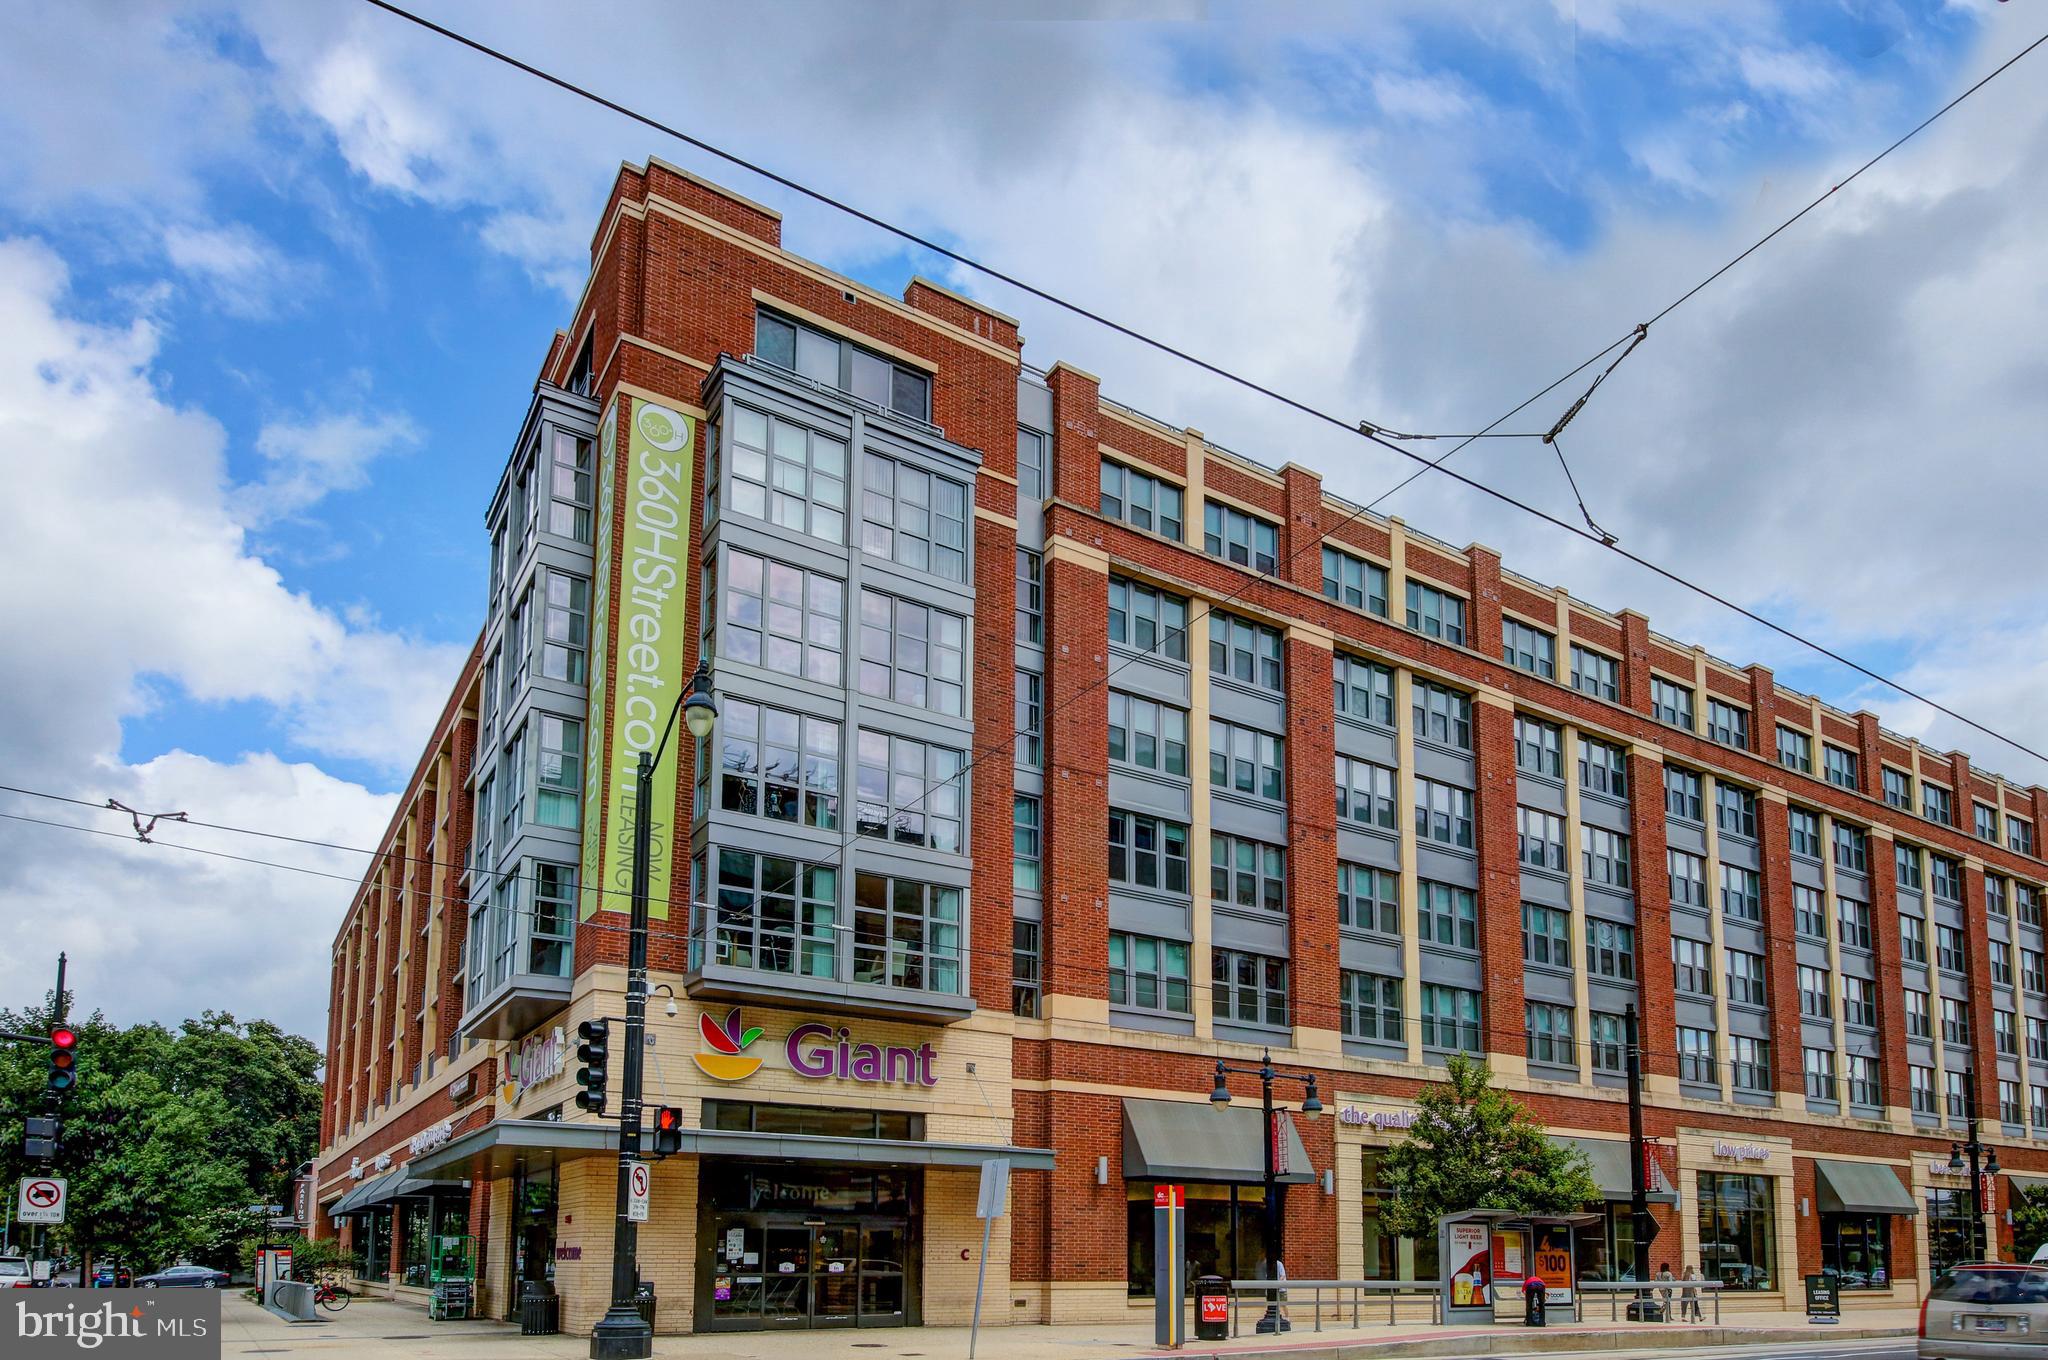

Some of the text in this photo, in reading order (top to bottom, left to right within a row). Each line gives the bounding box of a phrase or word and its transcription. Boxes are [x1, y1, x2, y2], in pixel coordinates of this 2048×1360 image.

[520, 1026, 565, 1089] Giant
[785, 1022, 939, 1087] Giant
[1342, 1104, 1370, 1125] the
[1713, 1140, 1736, 1157] low
[1539, 1254, 1567, 1272] $100
